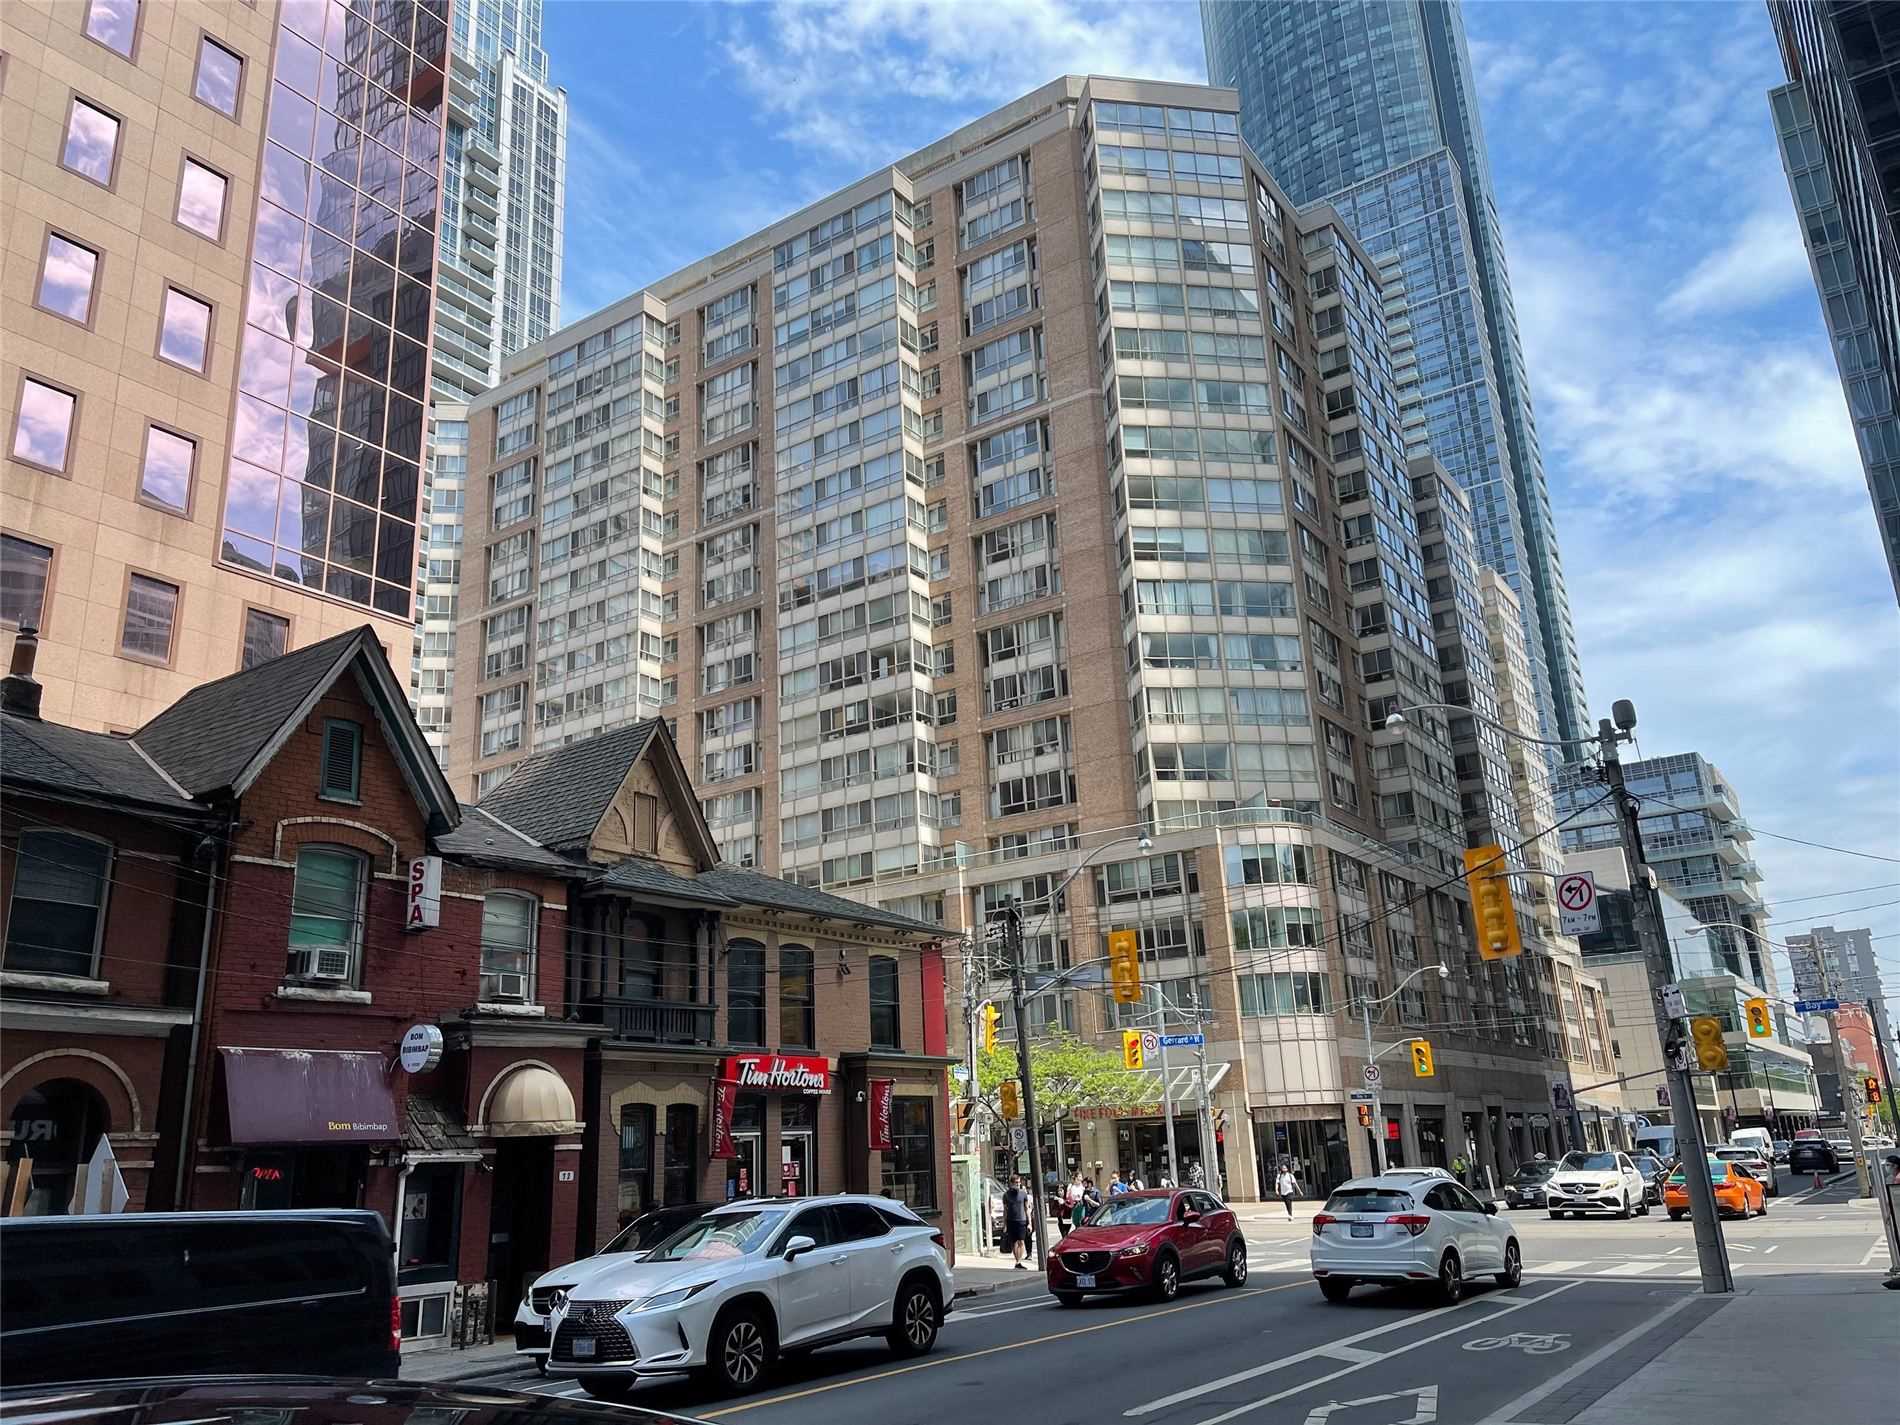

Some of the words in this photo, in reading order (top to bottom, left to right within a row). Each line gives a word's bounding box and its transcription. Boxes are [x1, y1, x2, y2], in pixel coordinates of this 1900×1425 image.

[411, 861, 425, 925] SPA
[1562, 915, 1575, 924] 7AM
[1583, 913, 1596, 921] 7PM
[1805, 1001, 1820, 1010] Bay
[1163, 1036, 1189, 1045] Gerrard
[1194, 1035, 1200, 1043] W
[403, 1045, 429, 1053] BIBIMBAP
[740, 1058, 768, 1087] Tim
[768, 1058, 825, 1088] Hortons
[328, 1121, 352, 1131] Bom
[352, 1122, 388, 1132] Bibimbap
